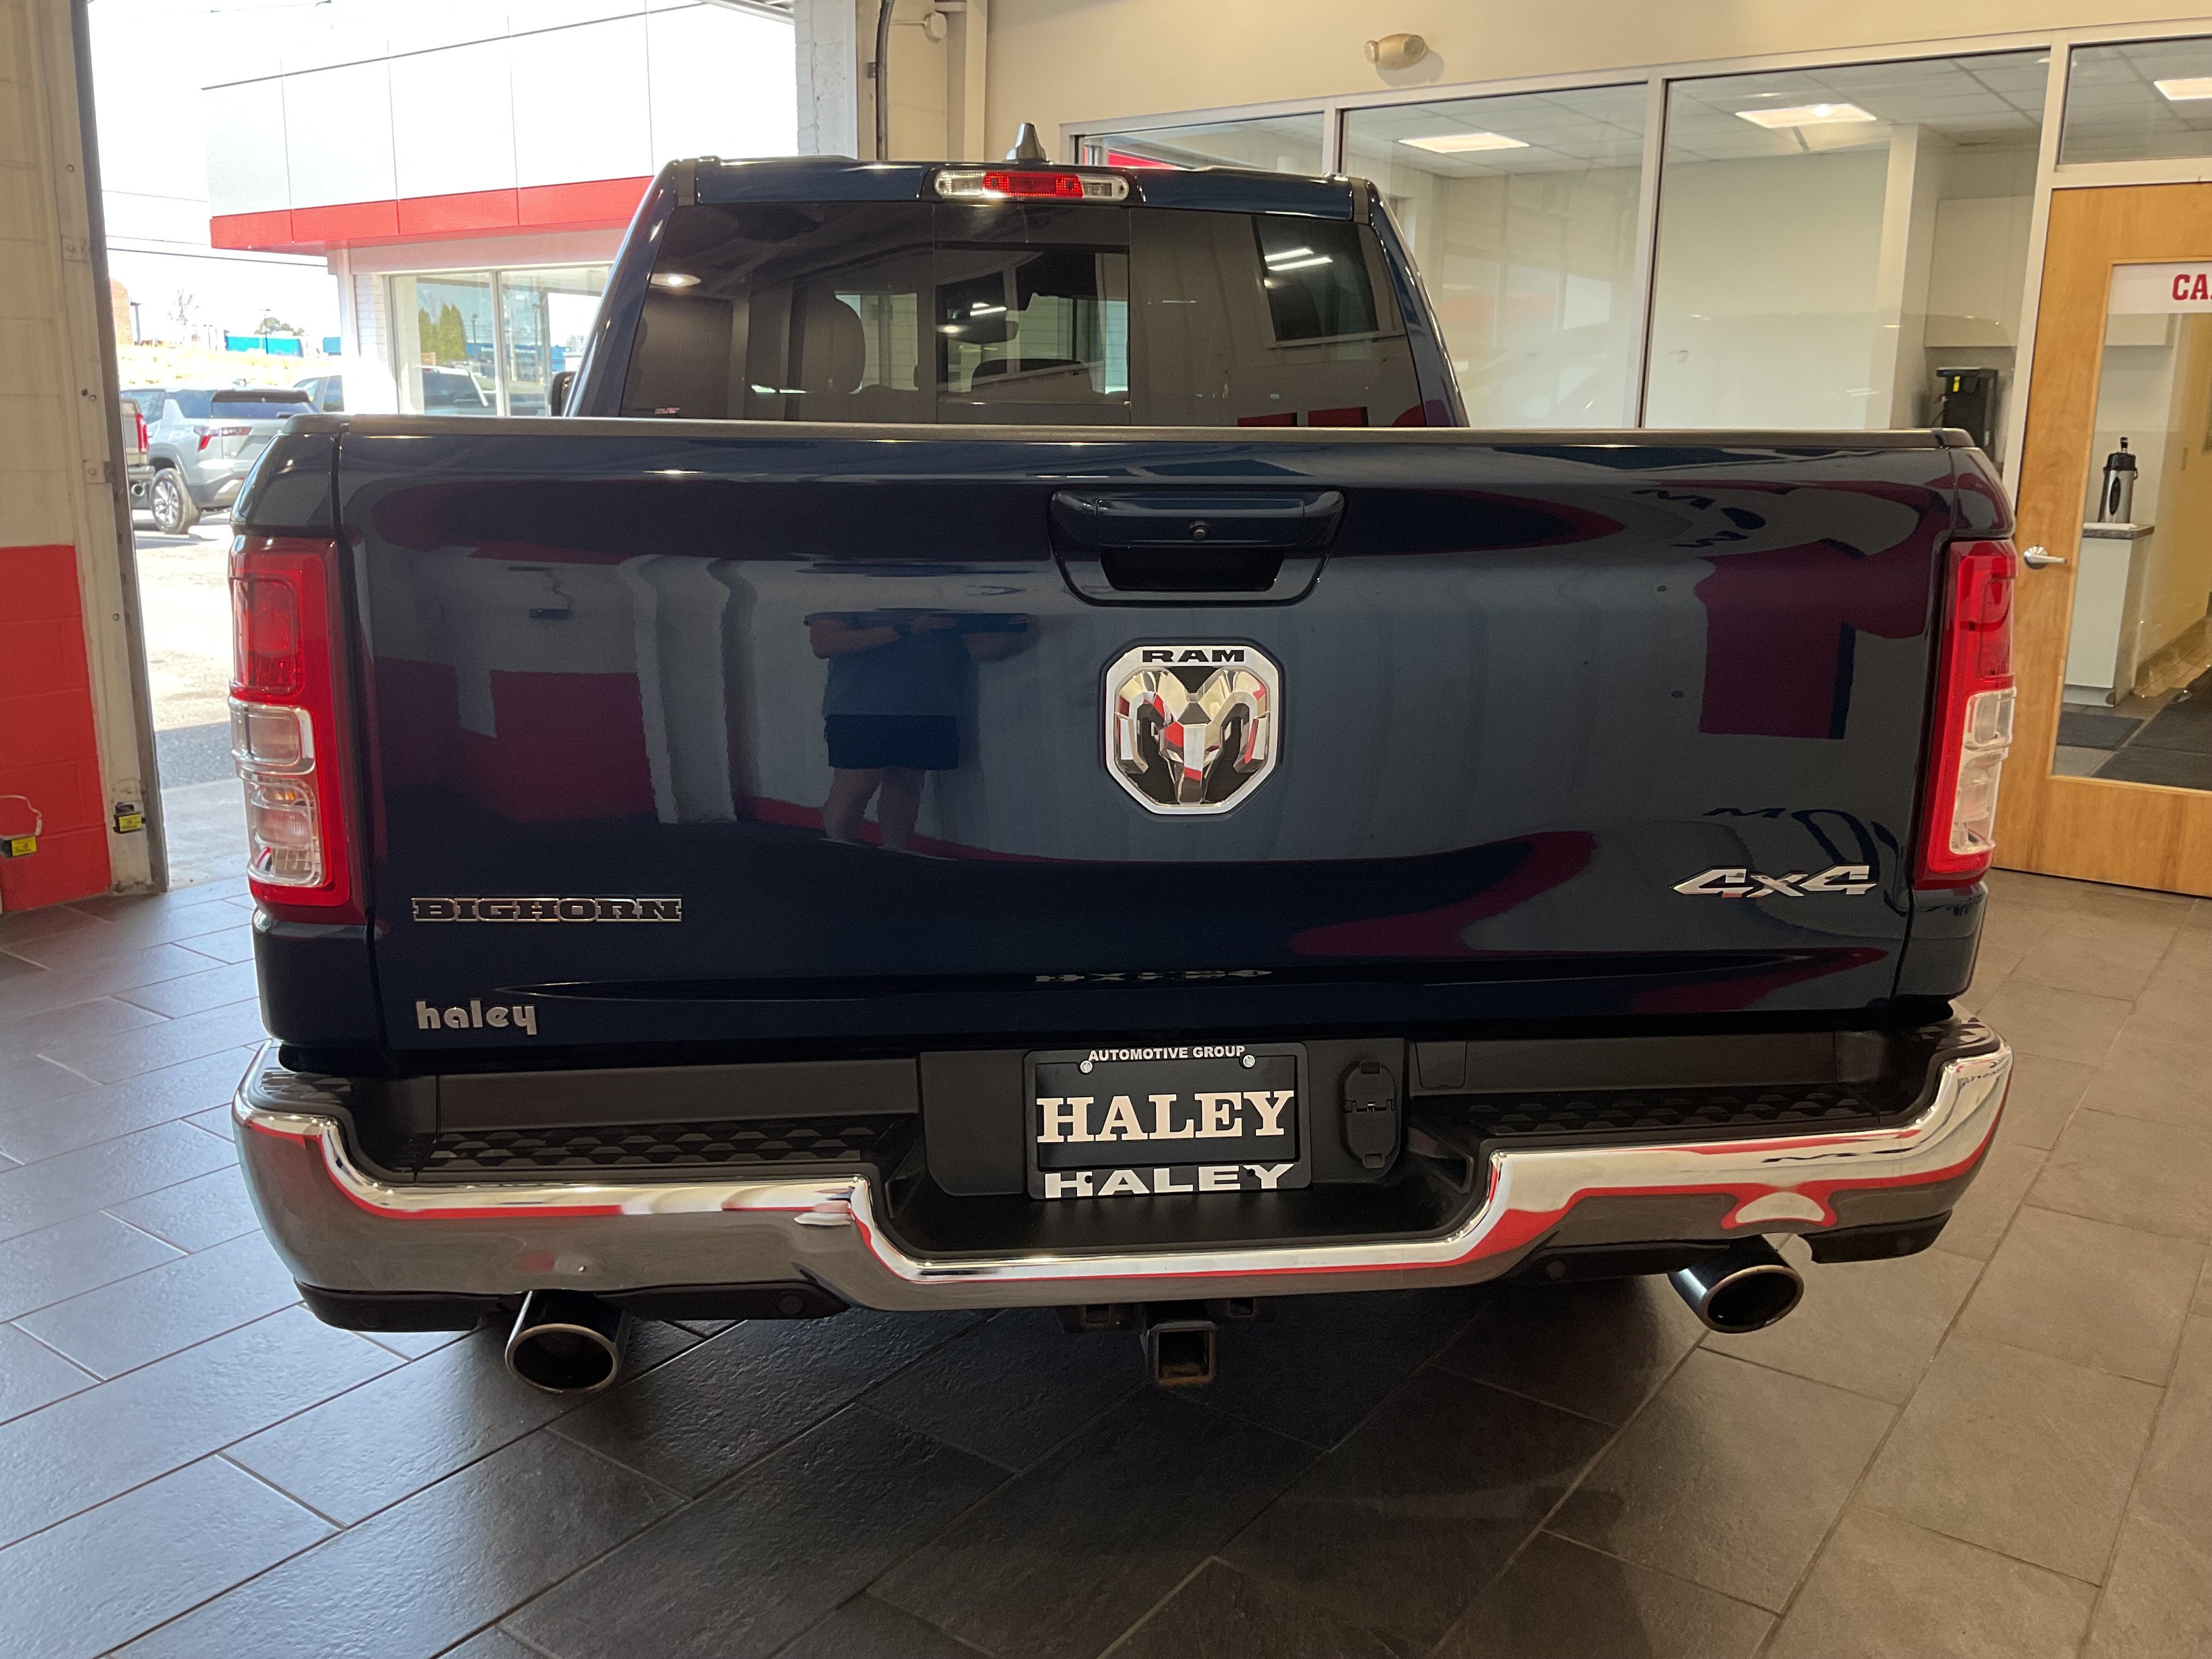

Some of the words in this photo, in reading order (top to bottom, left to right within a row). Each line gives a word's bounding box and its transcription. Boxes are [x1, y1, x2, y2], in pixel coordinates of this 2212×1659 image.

[2172, 274, 2212, 301] CA
[1142, 650, 1244, 663] RAM
[1672, 865, 1877, 898] 4x4
[411, 898, 682, 922] BIGHORN
[415, 1000, 537, 1035] haley
[1088, 1047, 1188, 1062] AUTOMOTIVE
[1193, 1045, 1245, 1059] GROUP
[1036, 1090, 1294, 1143] HALEY
[1044, 1163, 1294, 1199] HALEY
